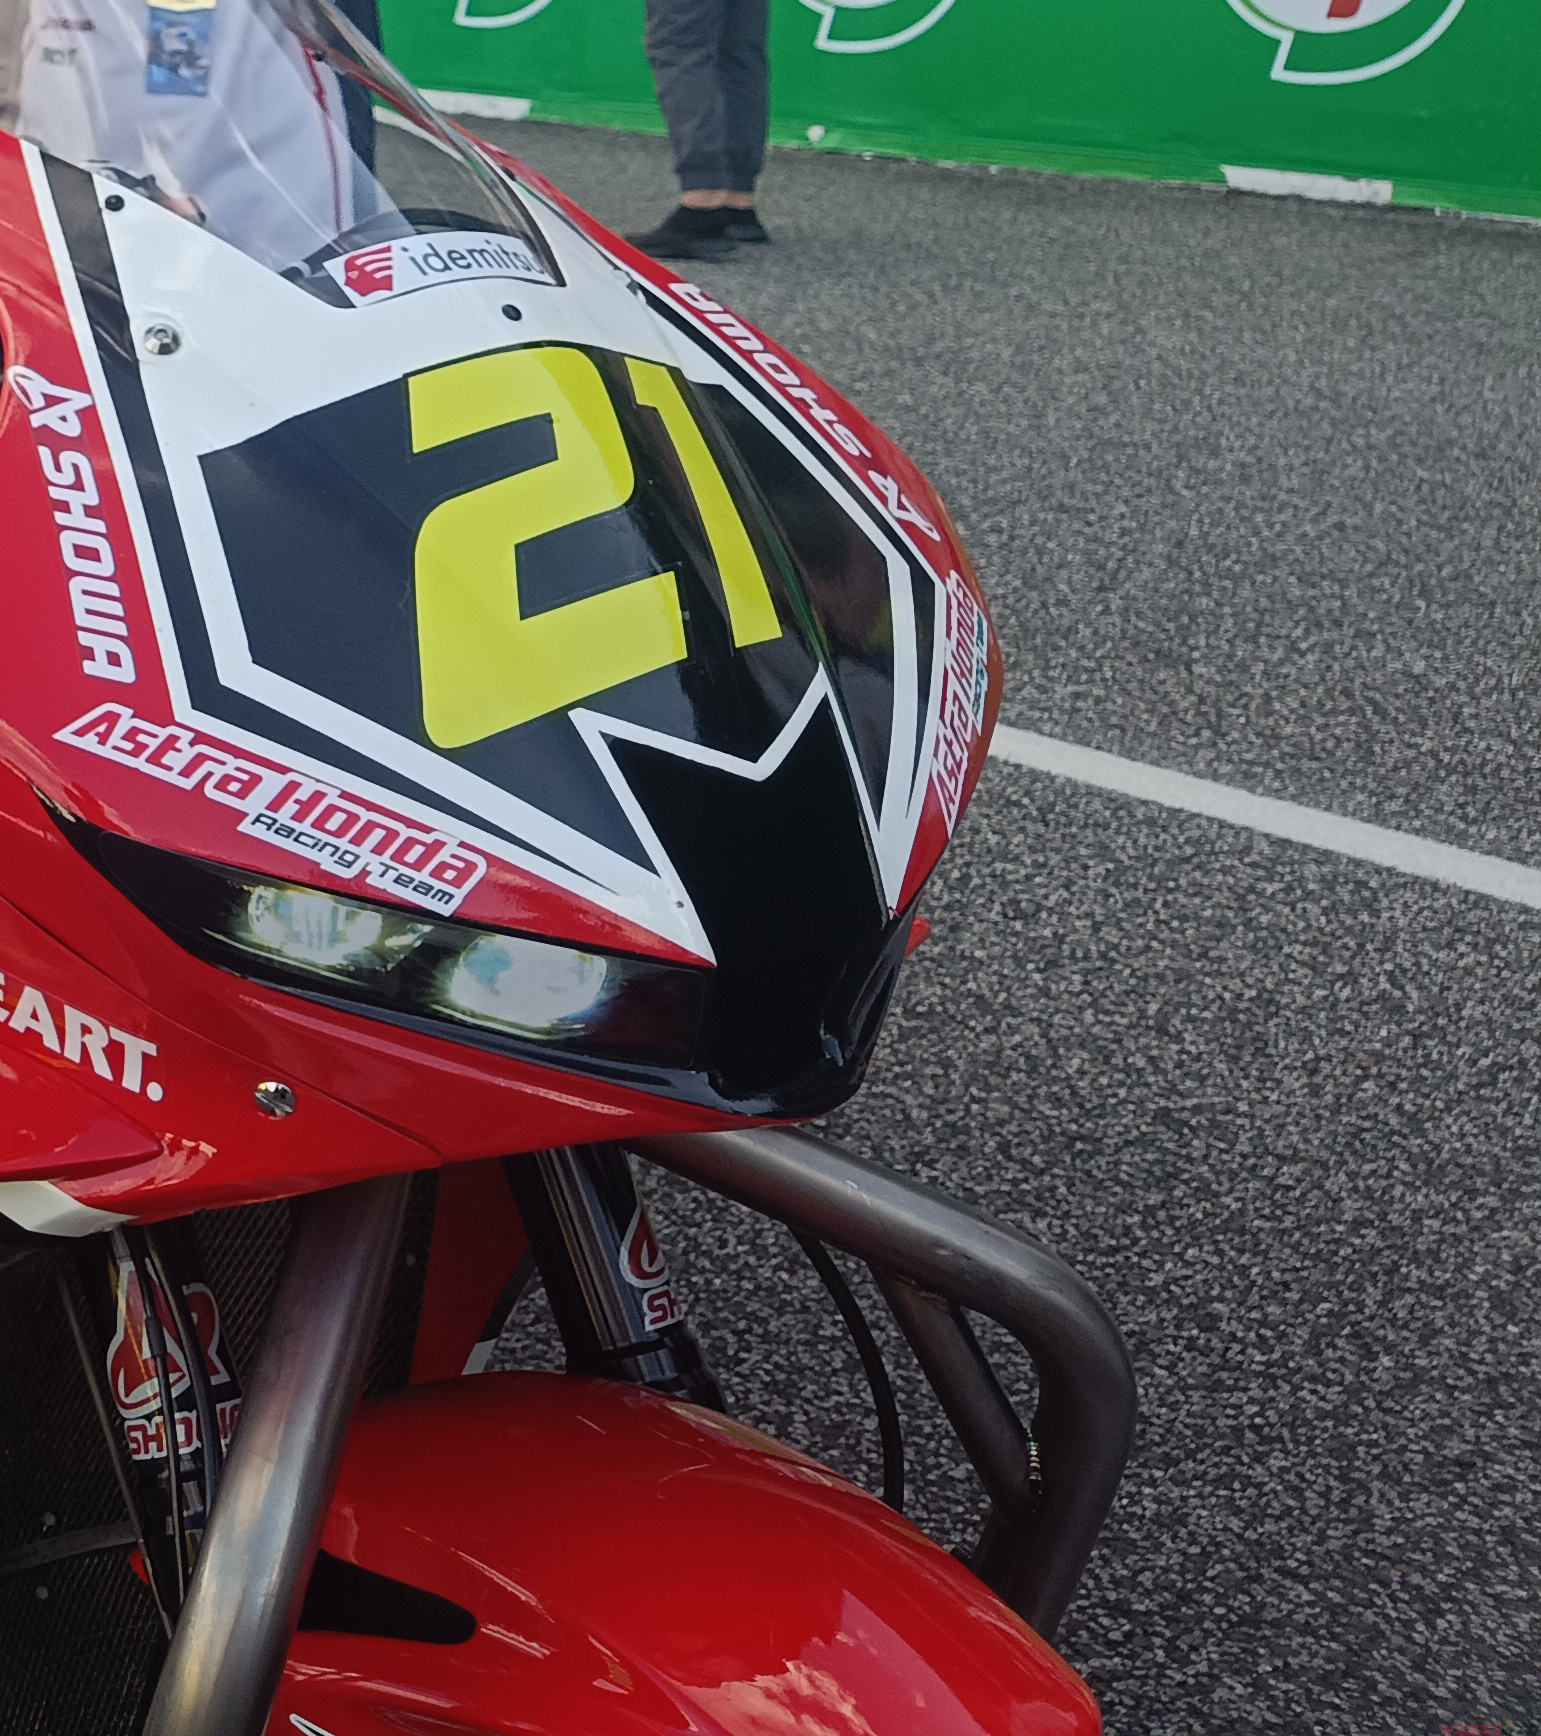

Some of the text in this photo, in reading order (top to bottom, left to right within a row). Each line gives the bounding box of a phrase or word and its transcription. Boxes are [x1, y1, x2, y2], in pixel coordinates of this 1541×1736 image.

[401, 238, 545, 277] idemitsu
[680, 280, 866, 458] SHOWA
[44, 450, 136, 684] SHOWA
[407, 344, 783, 749] 21
[71, 706, 480, 888] Astra Honda
[249, 807, 457, 907] Racing Team
